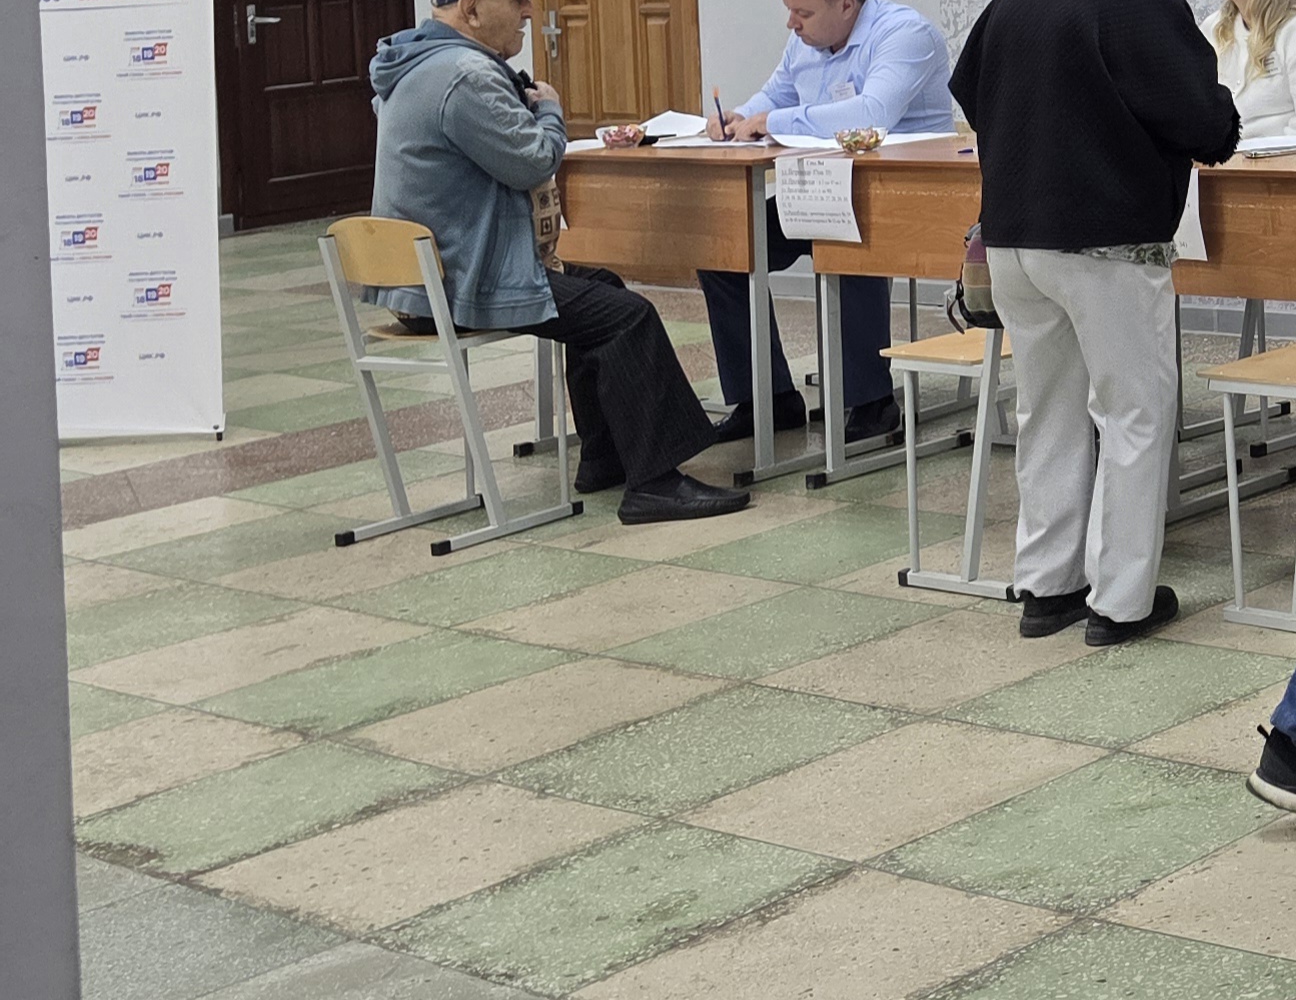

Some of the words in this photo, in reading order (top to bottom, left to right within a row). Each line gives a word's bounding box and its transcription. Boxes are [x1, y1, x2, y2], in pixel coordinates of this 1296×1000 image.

[154, 44, 166, 55] 20
[83, 108, 95, 118] 20
[156, 165, 168, 174] 20
[85, 228, 97, 238] 20
[158, 285, 170, 295] 20
[87, 350, 99, 359] 20
